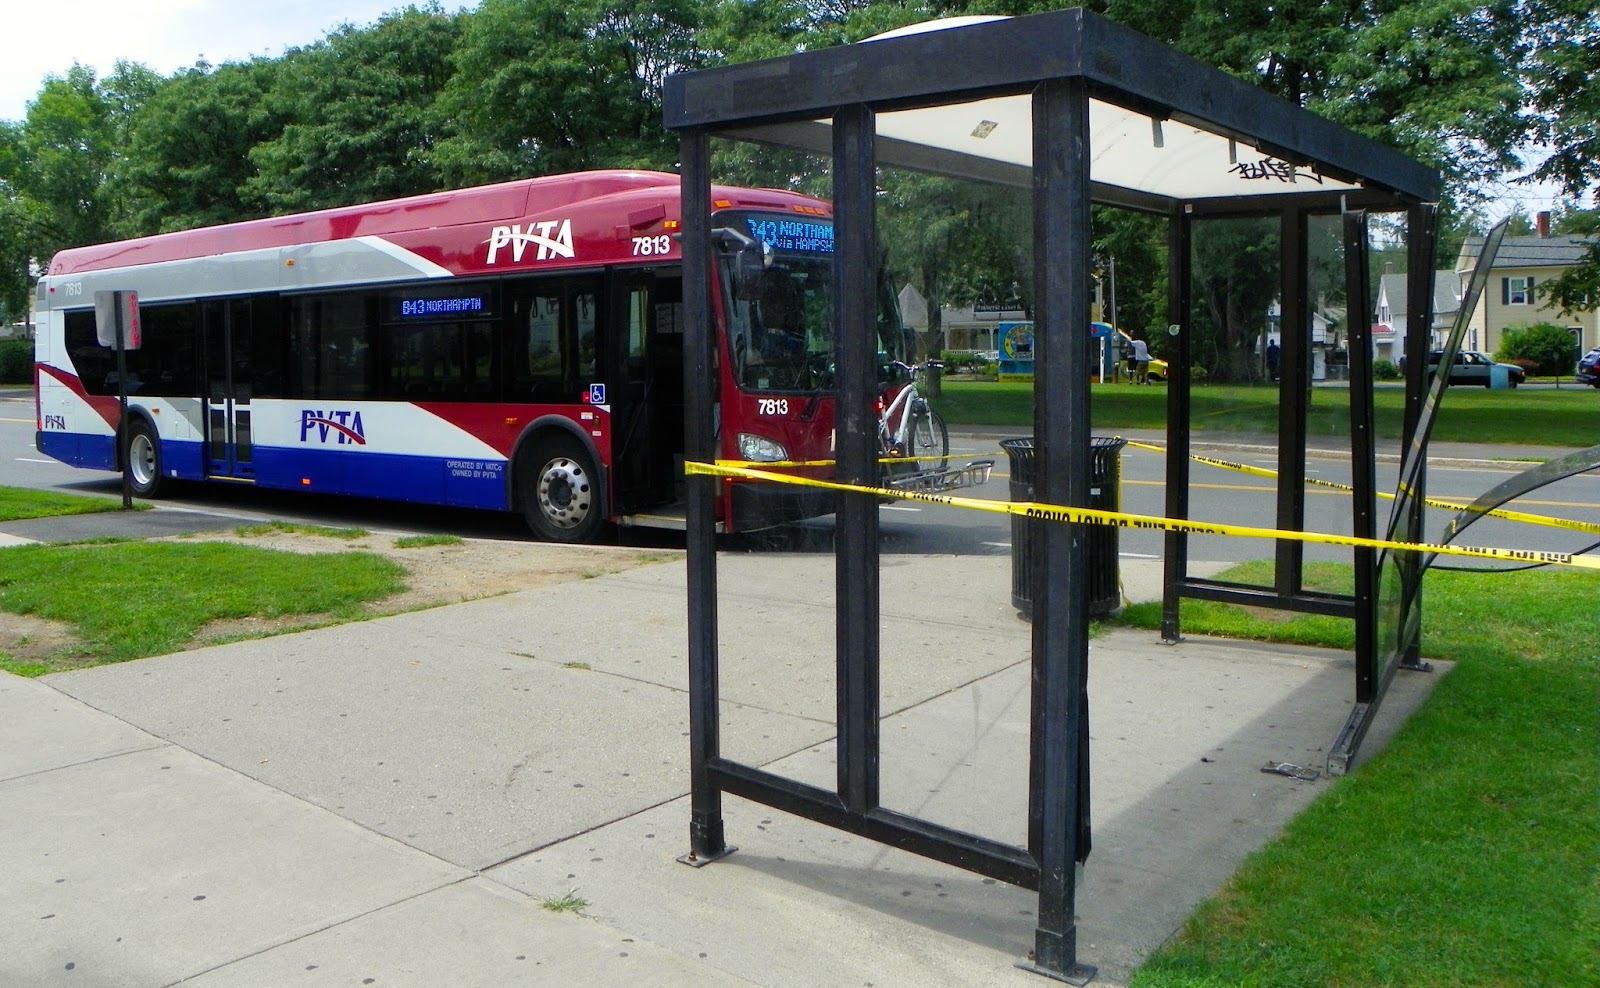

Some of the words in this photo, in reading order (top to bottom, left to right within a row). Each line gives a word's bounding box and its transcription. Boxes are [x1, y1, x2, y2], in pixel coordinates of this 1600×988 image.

[780, 220, 835, 240] NORTHAM
[485, 218, 575, 265] PVTA
[632, 235, 671, 256] 7813
[776, 236, 793, 249] via
[65, 282, 82, 296] 7813
[129, 294, 137, 316] BUS
[402, 299, 425, 315] B43
[426, 297, 481, 312] NORTHAMPTN
[130, 318, 140, 347] STOP
[758, 398, 788, 415] 7813
[45, 414, 66, 430] PVTA
[299, 409, 366, 445] PVTA
[446, 460, 475, 470] OPERATED
[475, 462, 484, 470] BY
[451, 469, 473, 477] OWNED
[473, 470, 482, 478] BY
[482, 471, 497, 479] PVTA
